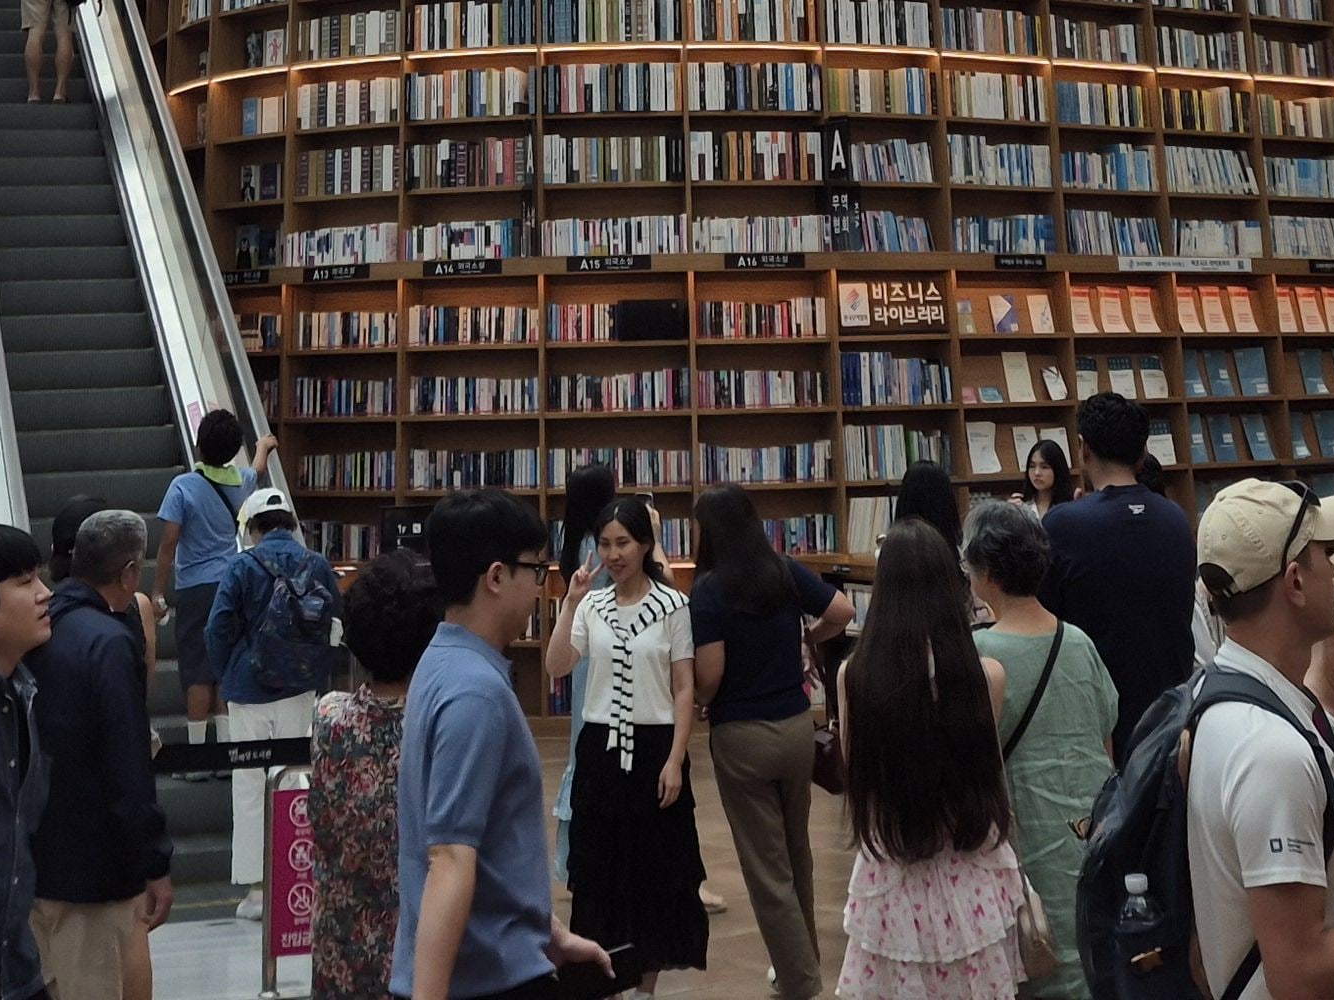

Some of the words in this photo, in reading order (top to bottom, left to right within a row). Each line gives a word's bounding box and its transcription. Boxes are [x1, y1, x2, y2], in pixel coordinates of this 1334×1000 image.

[830, 129, 847, 171] A
[579, 258, 601, 270] A15
[737, 255, 758, 267] A16
[312, 270, 329, 281] A13
[434, 263, 454, 275] A14
[871, 281, 942, 306] 비즈니스
[873, 304, 945, 327] 라이브러리
[281, 929, 313, 948] 진입금
